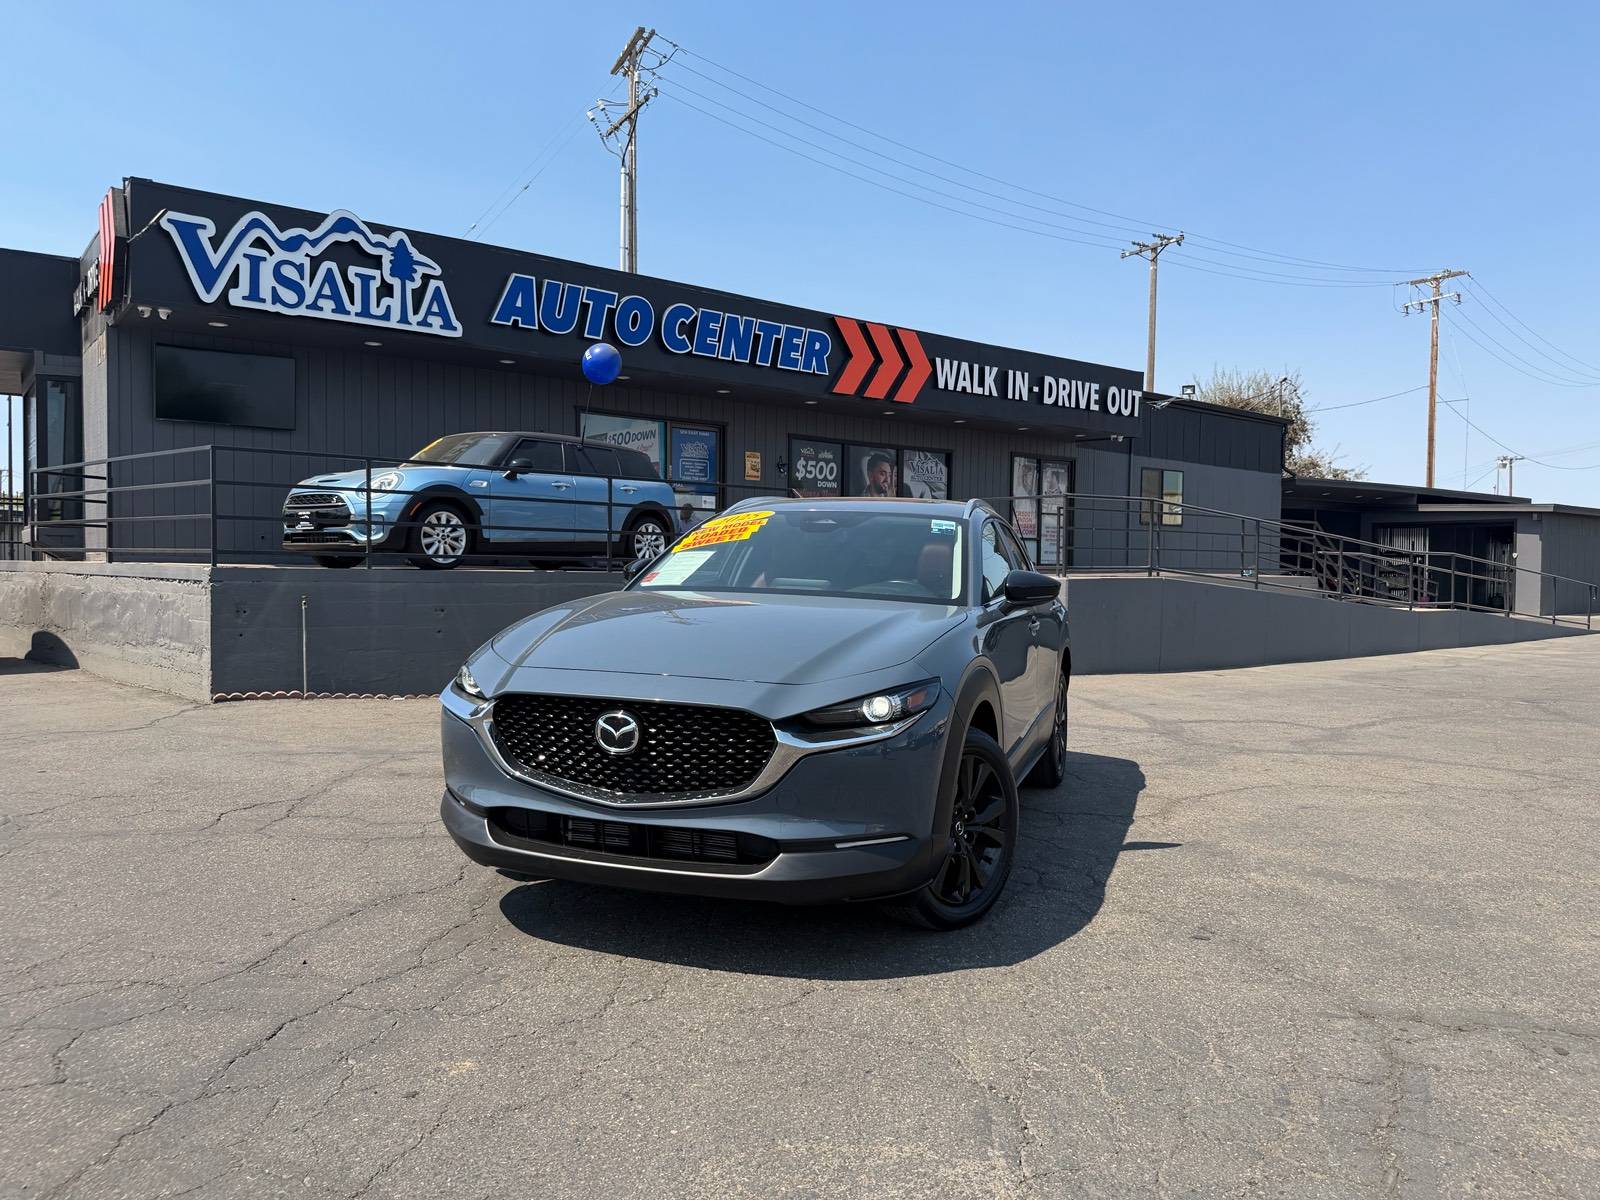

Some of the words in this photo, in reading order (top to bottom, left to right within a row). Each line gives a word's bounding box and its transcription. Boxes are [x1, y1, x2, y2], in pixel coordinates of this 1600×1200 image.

[160, 209, 463, 337] VISALIA
[490, 272, 655, 347] AUTO
[661, 303, 832, 376] CENTER
[935, 357, 999, 397] WALK
[1042, 375, 1100, 412] DRIVE
[1107, 386, 1142, 418] OUT
[607, 431, 631, 446] $500
[632, 429, 657, 443] DOWN
[795, 456, 837, 480] $500
[817, 481, 838, 489] DOWN
[722, 519, 764, 530] MODEL
